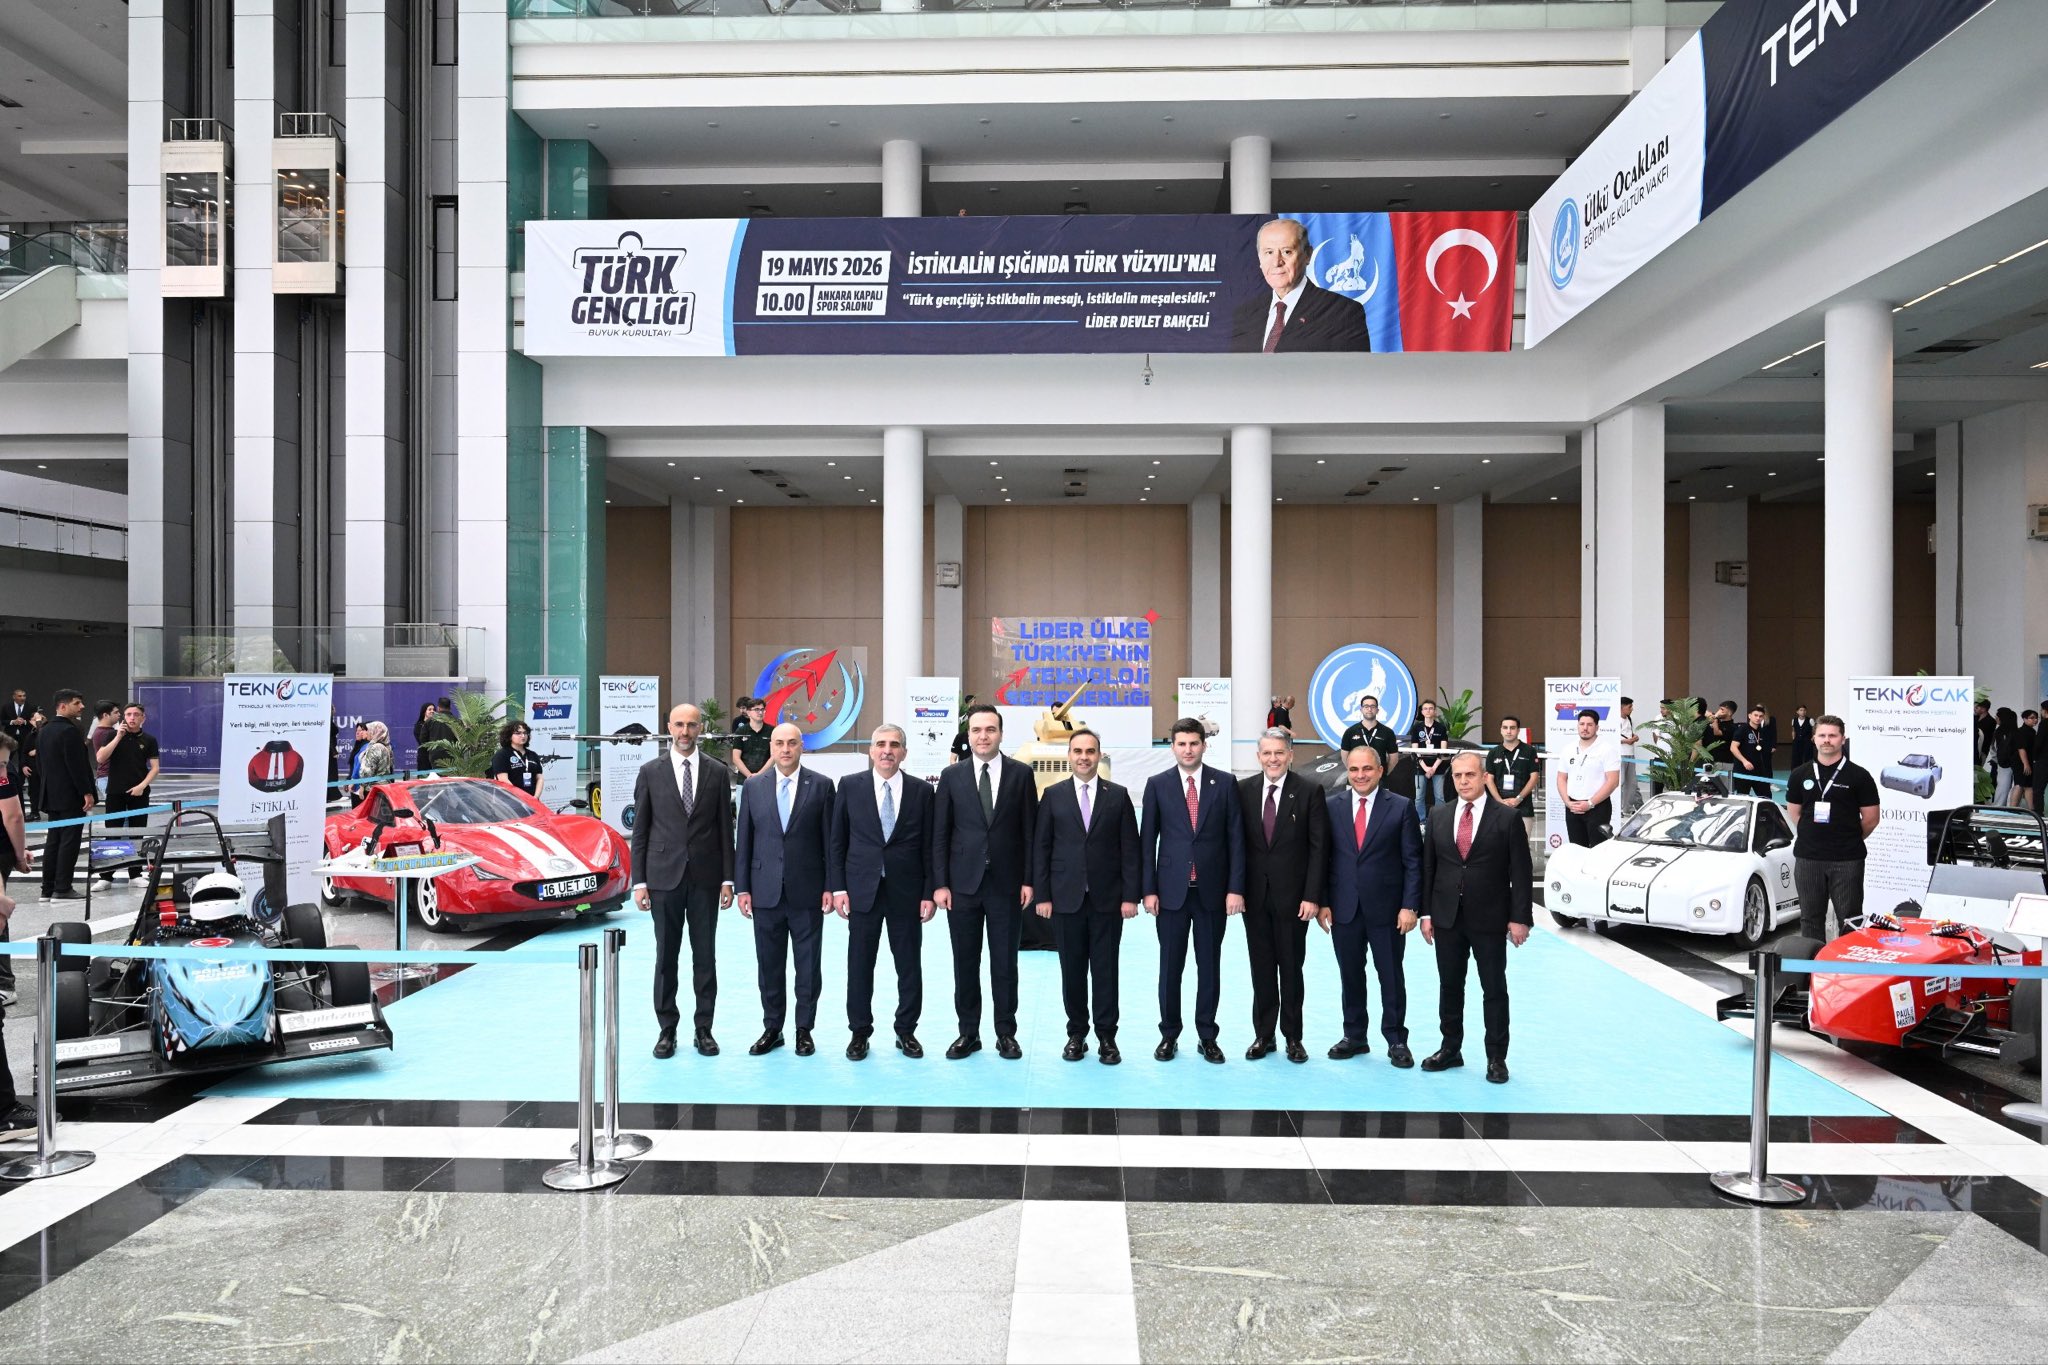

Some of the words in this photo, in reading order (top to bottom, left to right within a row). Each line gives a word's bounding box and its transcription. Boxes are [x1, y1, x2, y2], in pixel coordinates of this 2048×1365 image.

[1584, 221, 1606, 249] EĞİTİM
[1606, 212, 1616, 229] VE
[1616, 186, 1645, 219] KÜLTÜR
[1645, 164, 1669, 195] VAKFI
[767, 257, 785, 276] 19
[788, 257, 838, 276] MAYIS
[841, 257, 883, 276] 2026
[907, 251, 996, 274] İSTİKLALİN
[998, 250, 1070, 279] IŞIĞINDA
[1073, 250, 1118, 273] TÜRK
[580, 255, 679, 294] TÜRK
[761, 292, 805, 312] 10.00
[818, 290, 852, 301] ANKARA
[853, 290, 883, 301] KAPALI
[935, 293, 985, 309] gençliği;
[986, 293, 1041, 306] istikbalin
[1043, 292, 1084, 307] mesajı,
[1086, 292, 1138, 305] istiklalin
[816, 301, 839, 312] SPOR
[840, 301, 873, 312] SALONU
[1085, 312, 1118, 329] LİDER
[1119, 315, 1162, 328] DEVLET
[1163, 312, 1210, 332] BAHÇELİ
[1020, 621, 1084, 640] LİDER
[1090, 618, 1150, 640] ÜLKE
[1028, 667, 1150, 685] TEKNOLOJİ
[1781, 871, 1790, 880] 22
[544, 884, 555, 896] 16
[558, 880, 580, 894] UET
[584, 877, 596, 889] 06
